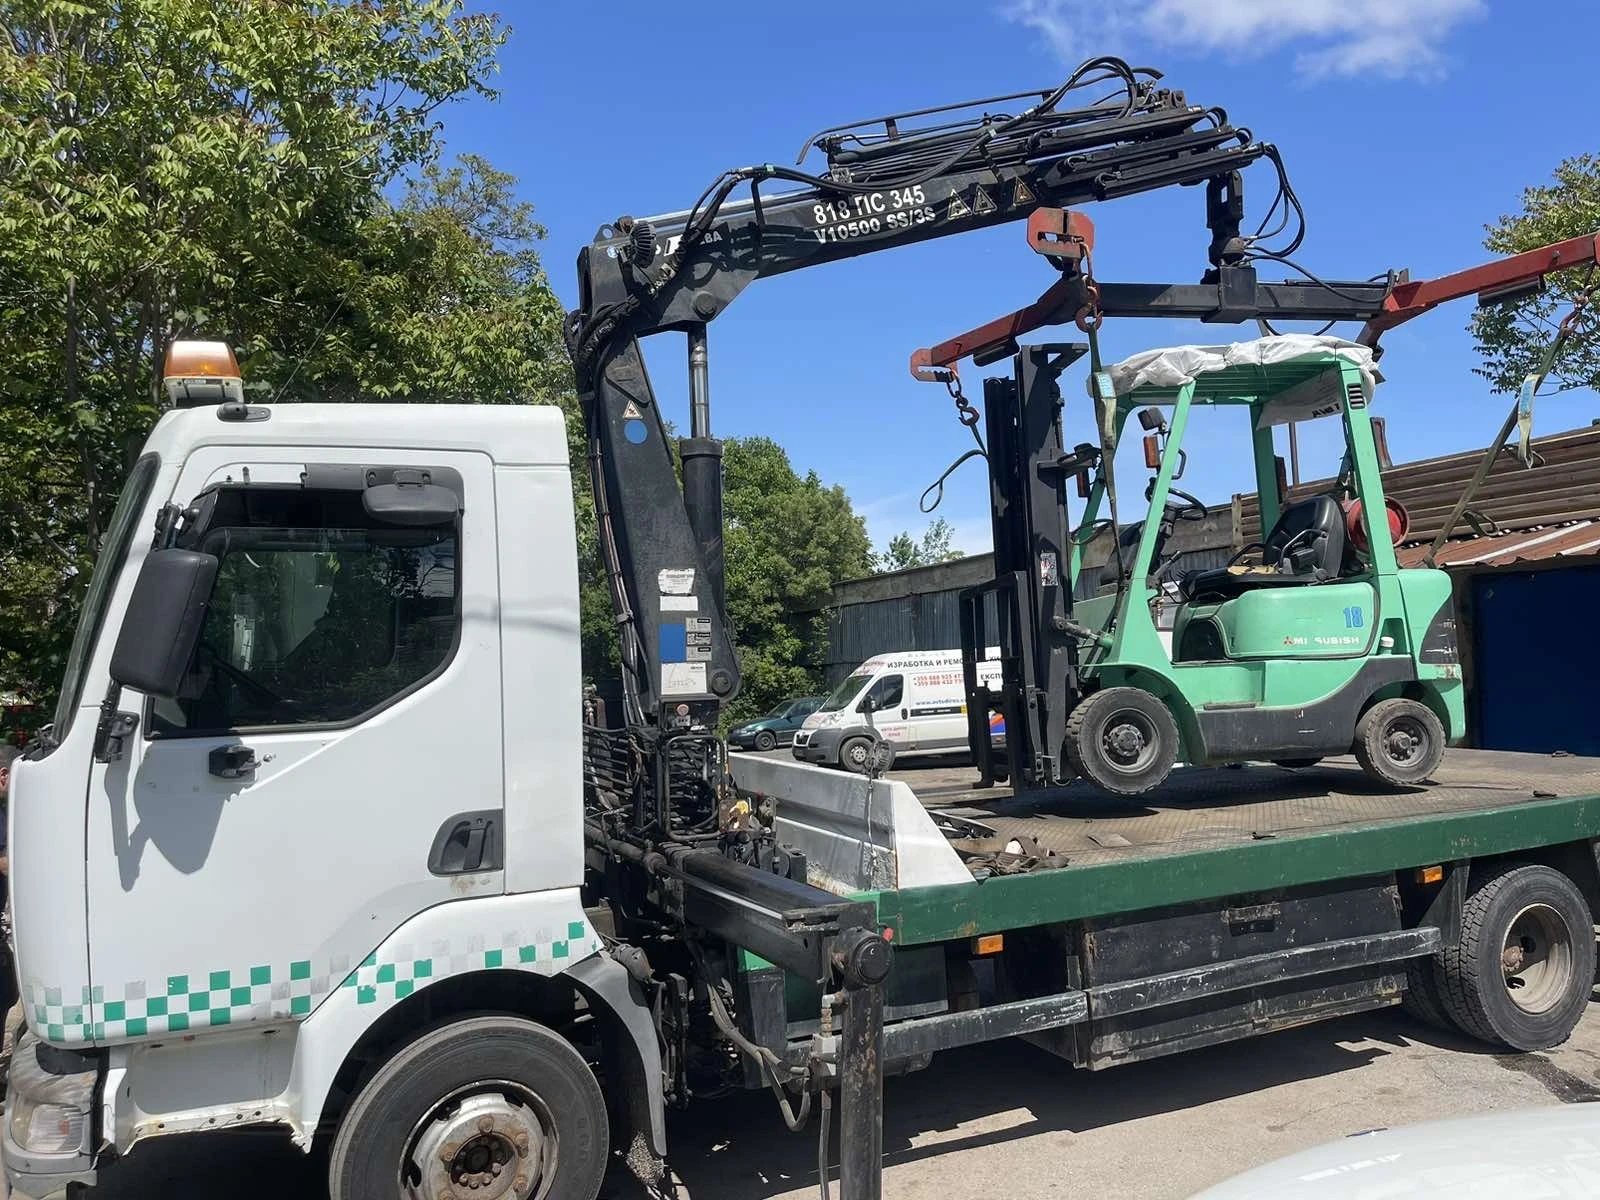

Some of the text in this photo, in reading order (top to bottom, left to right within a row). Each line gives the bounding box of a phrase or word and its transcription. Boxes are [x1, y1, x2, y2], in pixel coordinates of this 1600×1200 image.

[813, 200, 851, 225] 818
[889, 184, 926, 209] 345
[813, 206, 936, 244] V10500 SS/3S
[1343, 606, 1365, 628] 18
[887, 659, 934, 669] ИЗРАБОТКА
[935, 659, 943, 667] И
